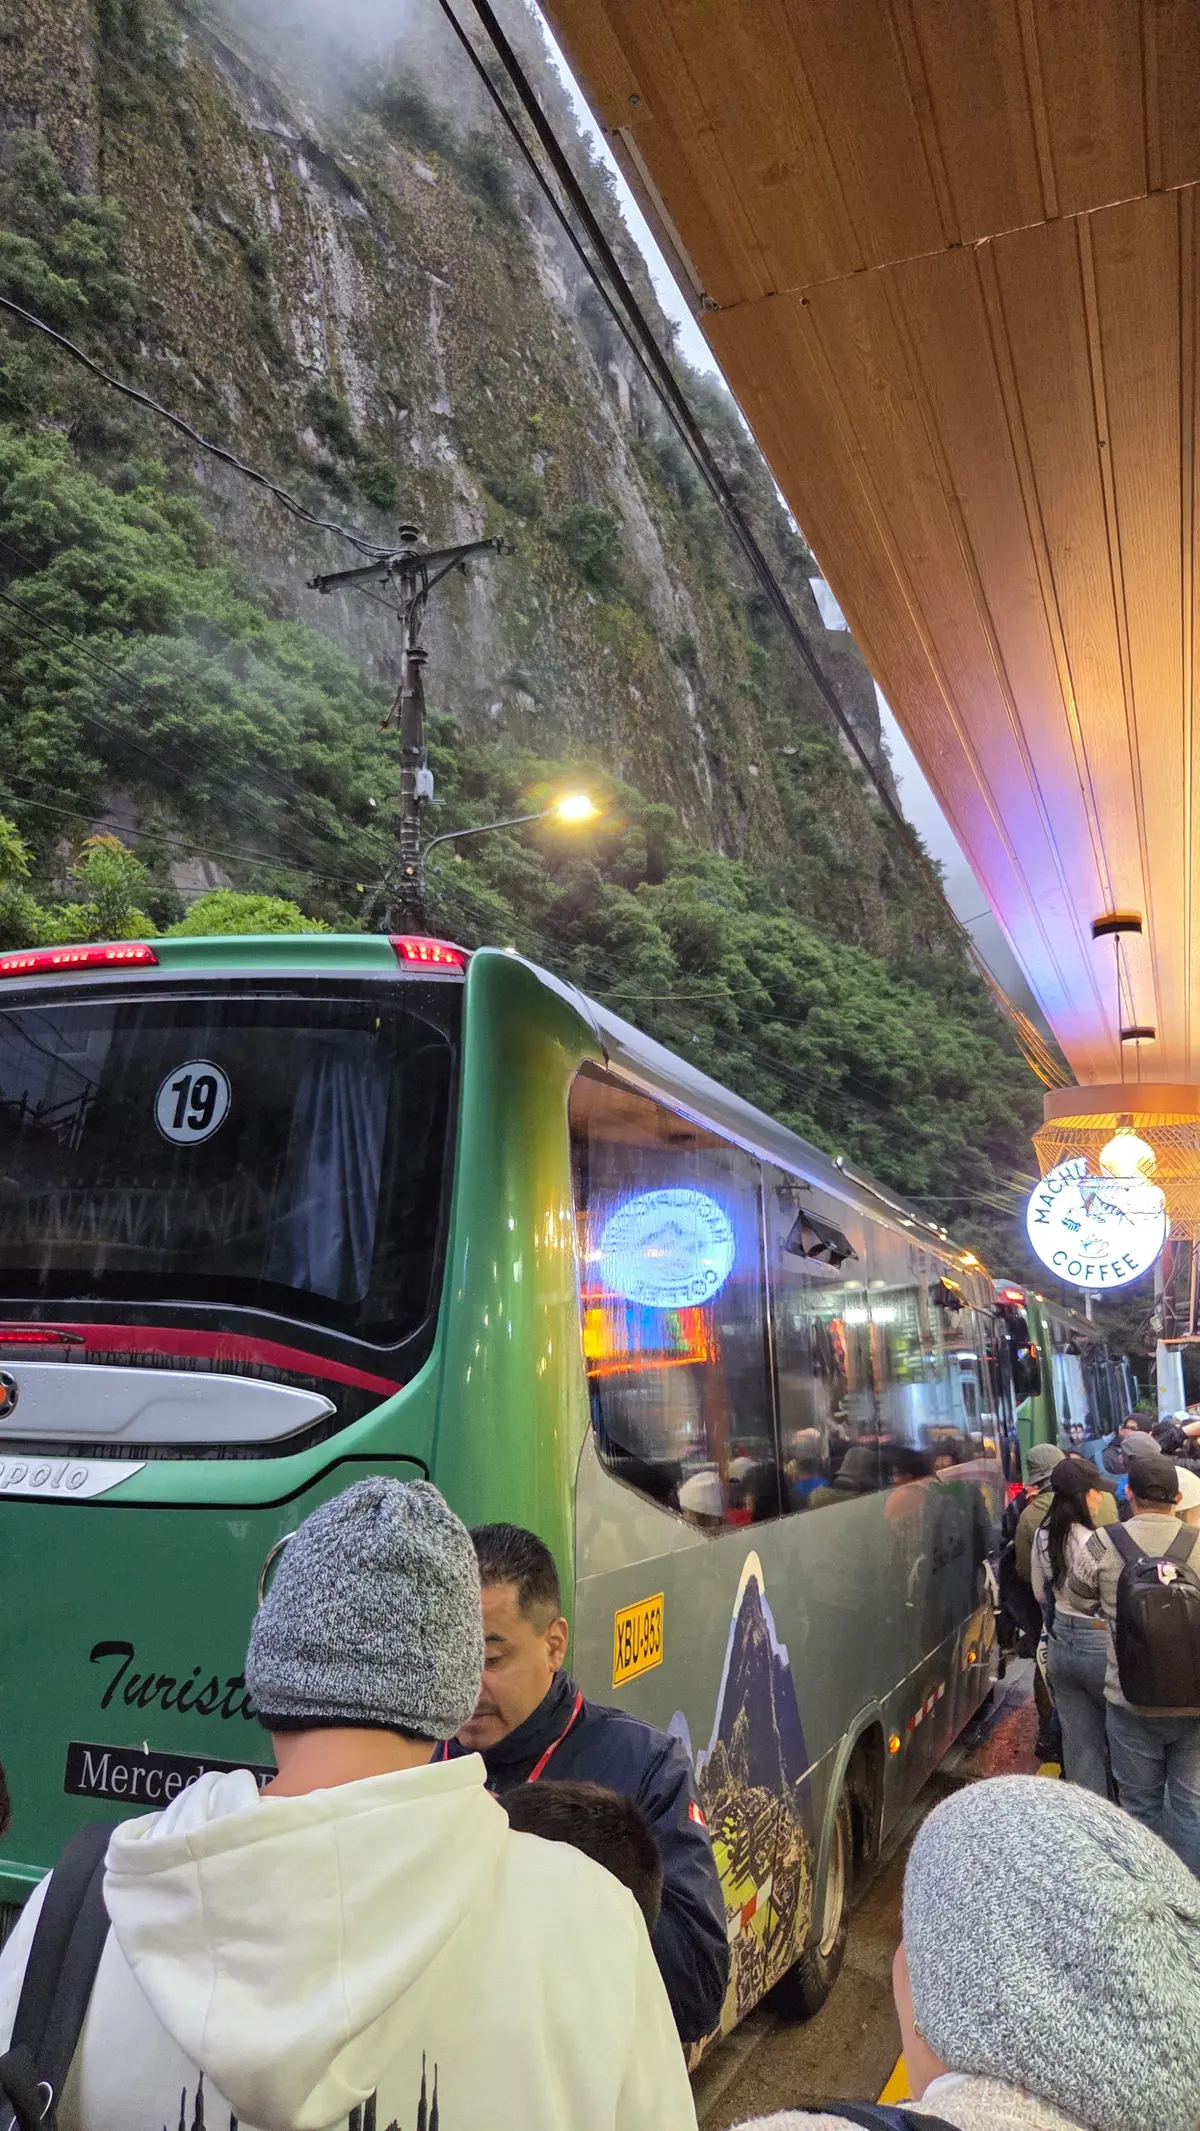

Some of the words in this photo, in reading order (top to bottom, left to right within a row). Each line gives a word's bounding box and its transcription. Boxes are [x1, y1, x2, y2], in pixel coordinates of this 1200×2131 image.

[171, 1074, 218, 1131] 19
[1052, 1250, 1139, 1281] COFFEE
[0, 1461, 89, 1490] polo
[615, 1607, 661, 1673] XBU-953
